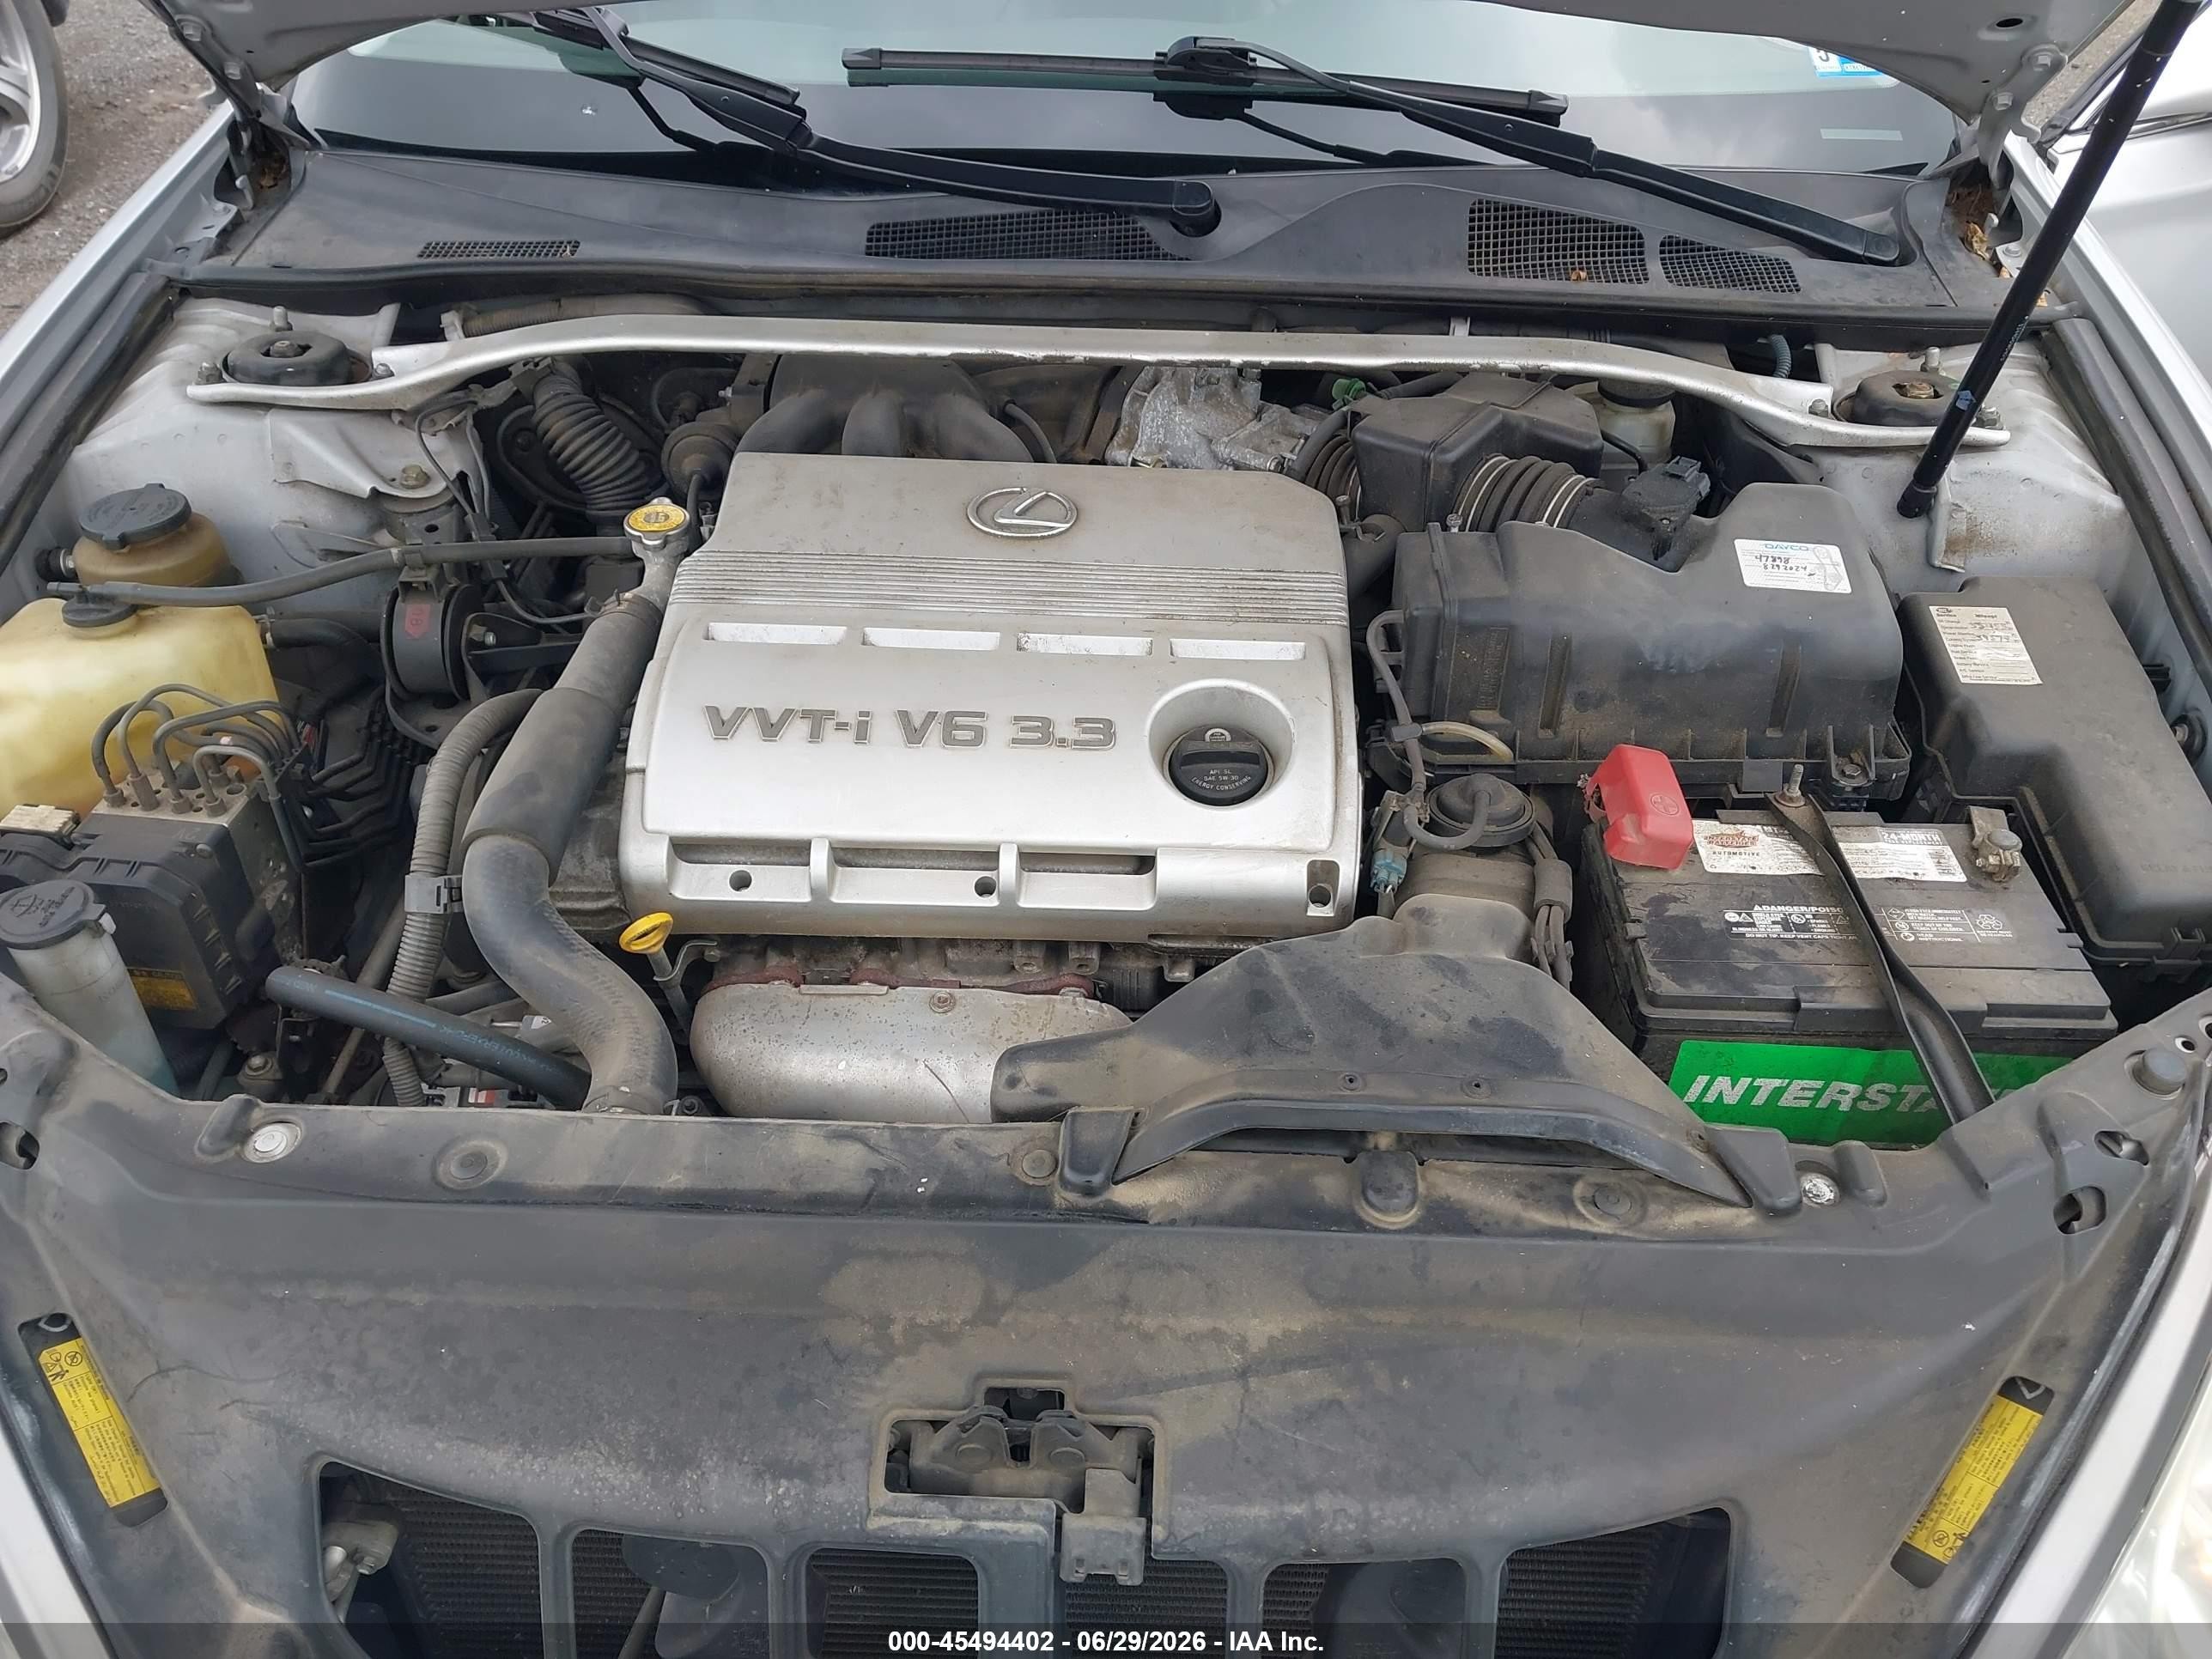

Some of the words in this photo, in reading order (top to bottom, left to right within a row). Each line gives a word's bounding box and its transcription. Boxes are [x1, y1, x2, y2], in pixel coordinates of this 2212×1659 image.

[704, 704, 872, 744] VVT-i
[896, 709, 988, 749] V6
[1008, 714, 1116, 750] 3.3
[1191, 776, 1215, 790] ENERGY
[1215, 775, 1252, 790] CONSERVING
[1881, 831, 1942, 842] 24-MONTH
